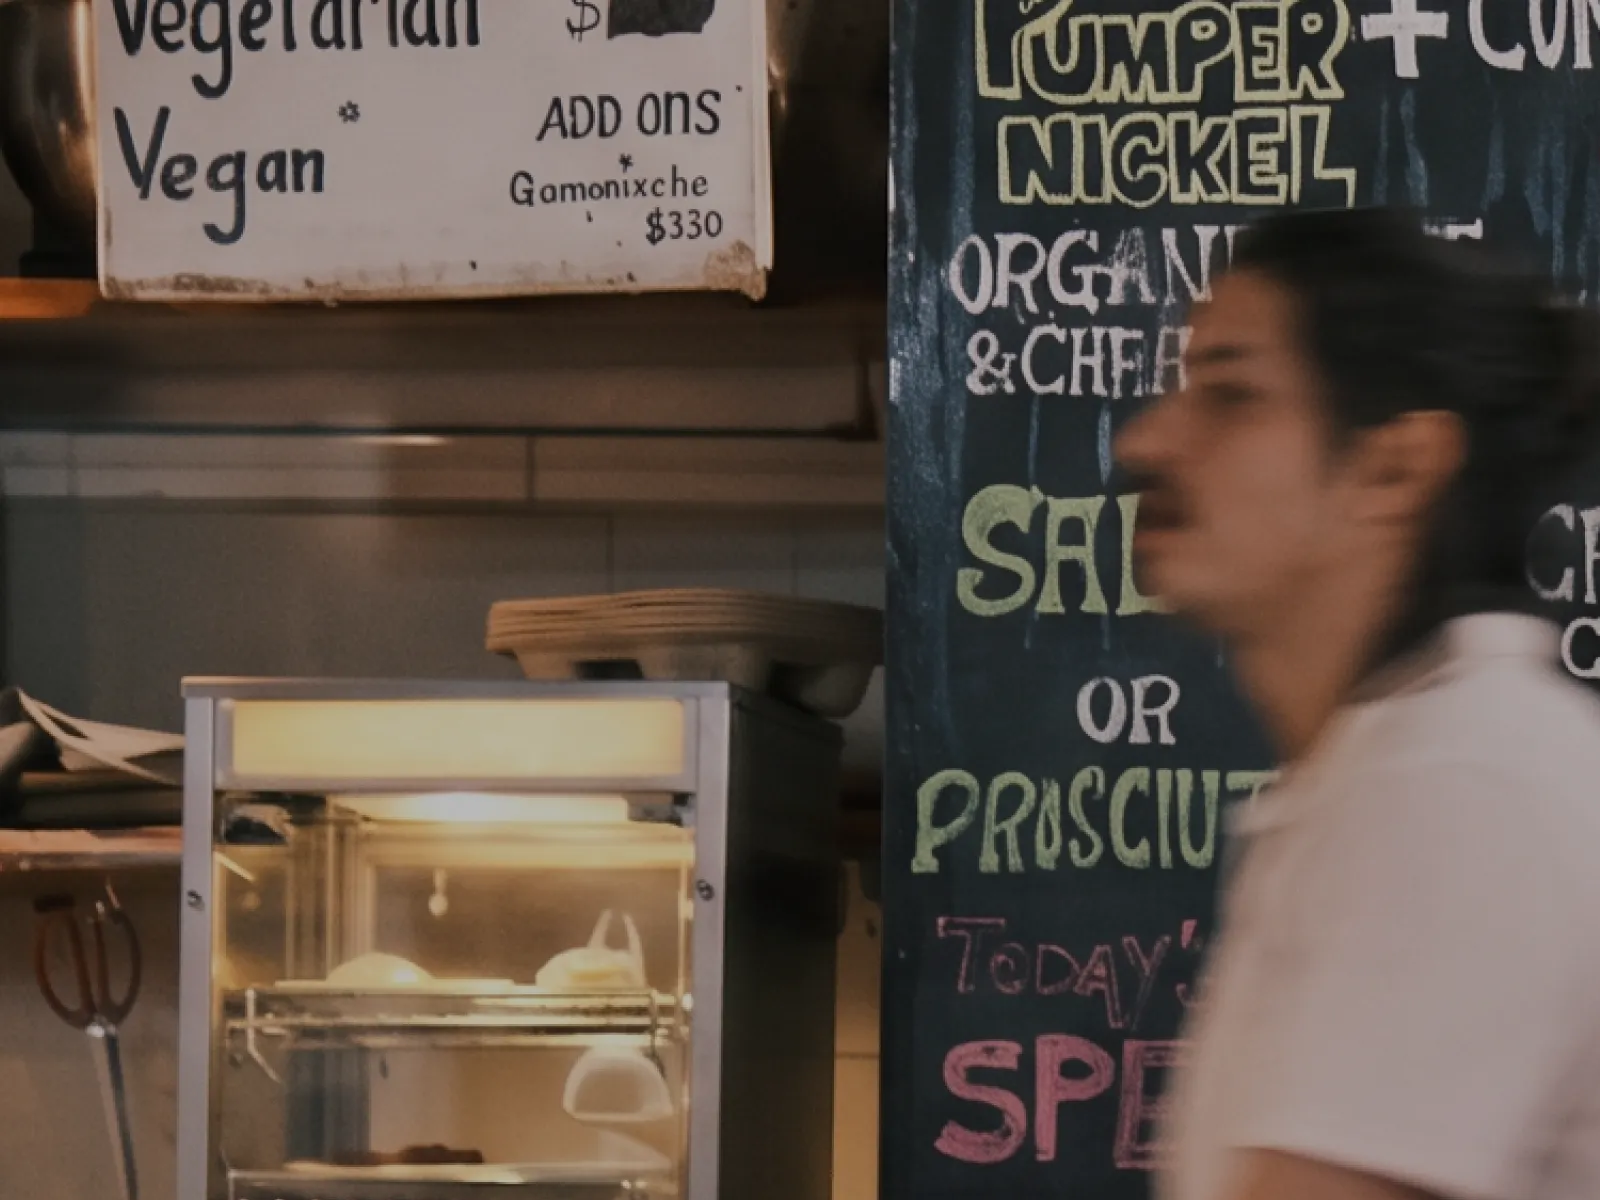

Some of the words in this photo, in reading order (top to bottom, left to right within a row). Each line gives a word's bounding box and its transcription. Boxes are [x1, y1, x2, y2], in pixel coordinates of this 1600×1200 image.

[975, 0, 1349, 104] PUMPER
[535, 93, 623, 142] ADD
[996, 104, 1358, 208] NICKEL
[113, 106, 325, 246] Vegan
[1077, 674, 1180, 744] OR
